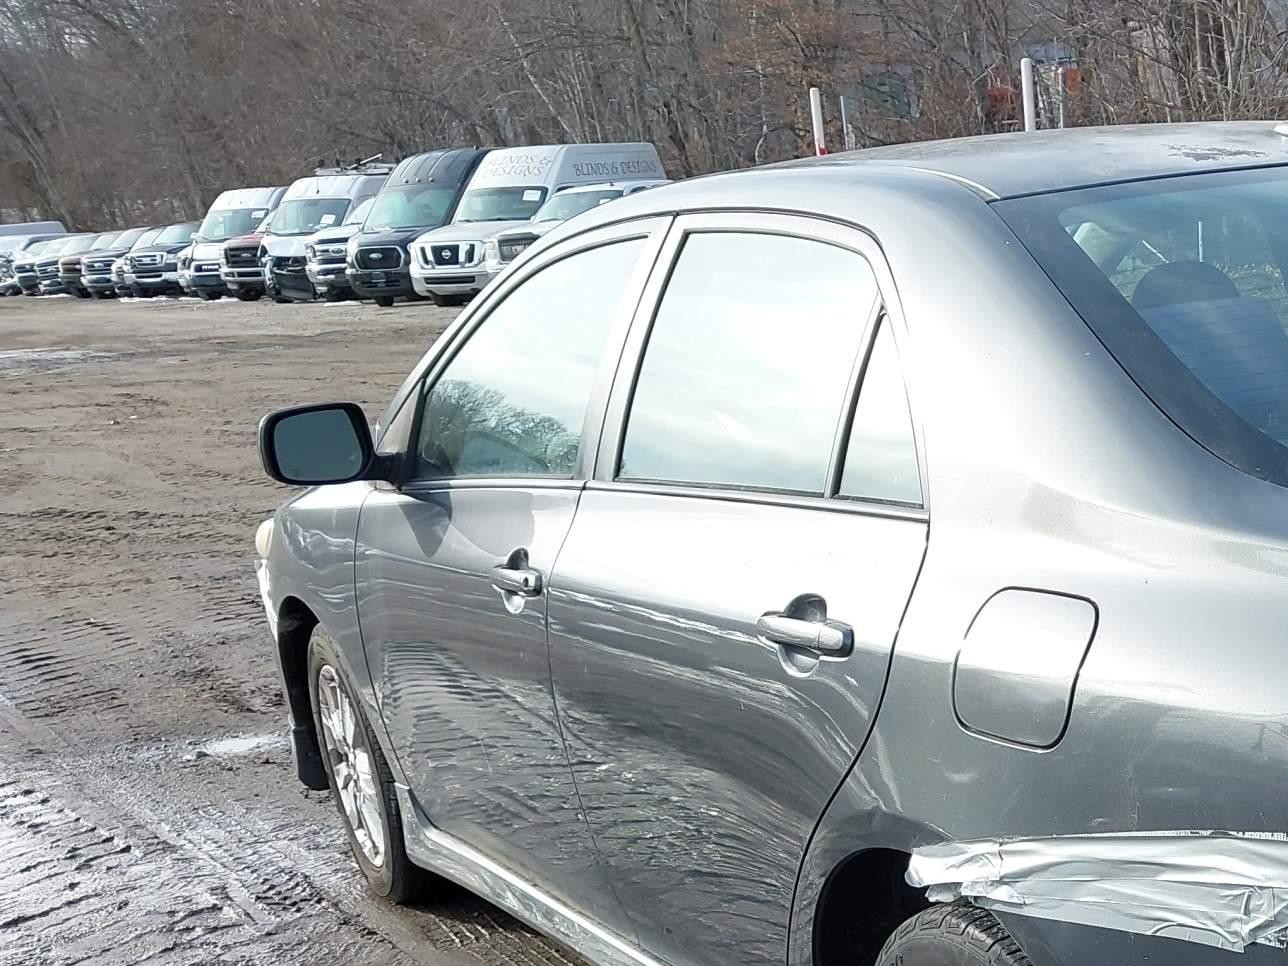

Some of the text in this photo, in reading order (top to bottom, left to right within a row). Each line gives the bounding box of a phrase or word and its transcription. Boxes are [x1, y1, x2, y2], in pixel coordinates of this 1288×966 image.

[573, 160, 657, 177] BLINDS & DESIGNS
